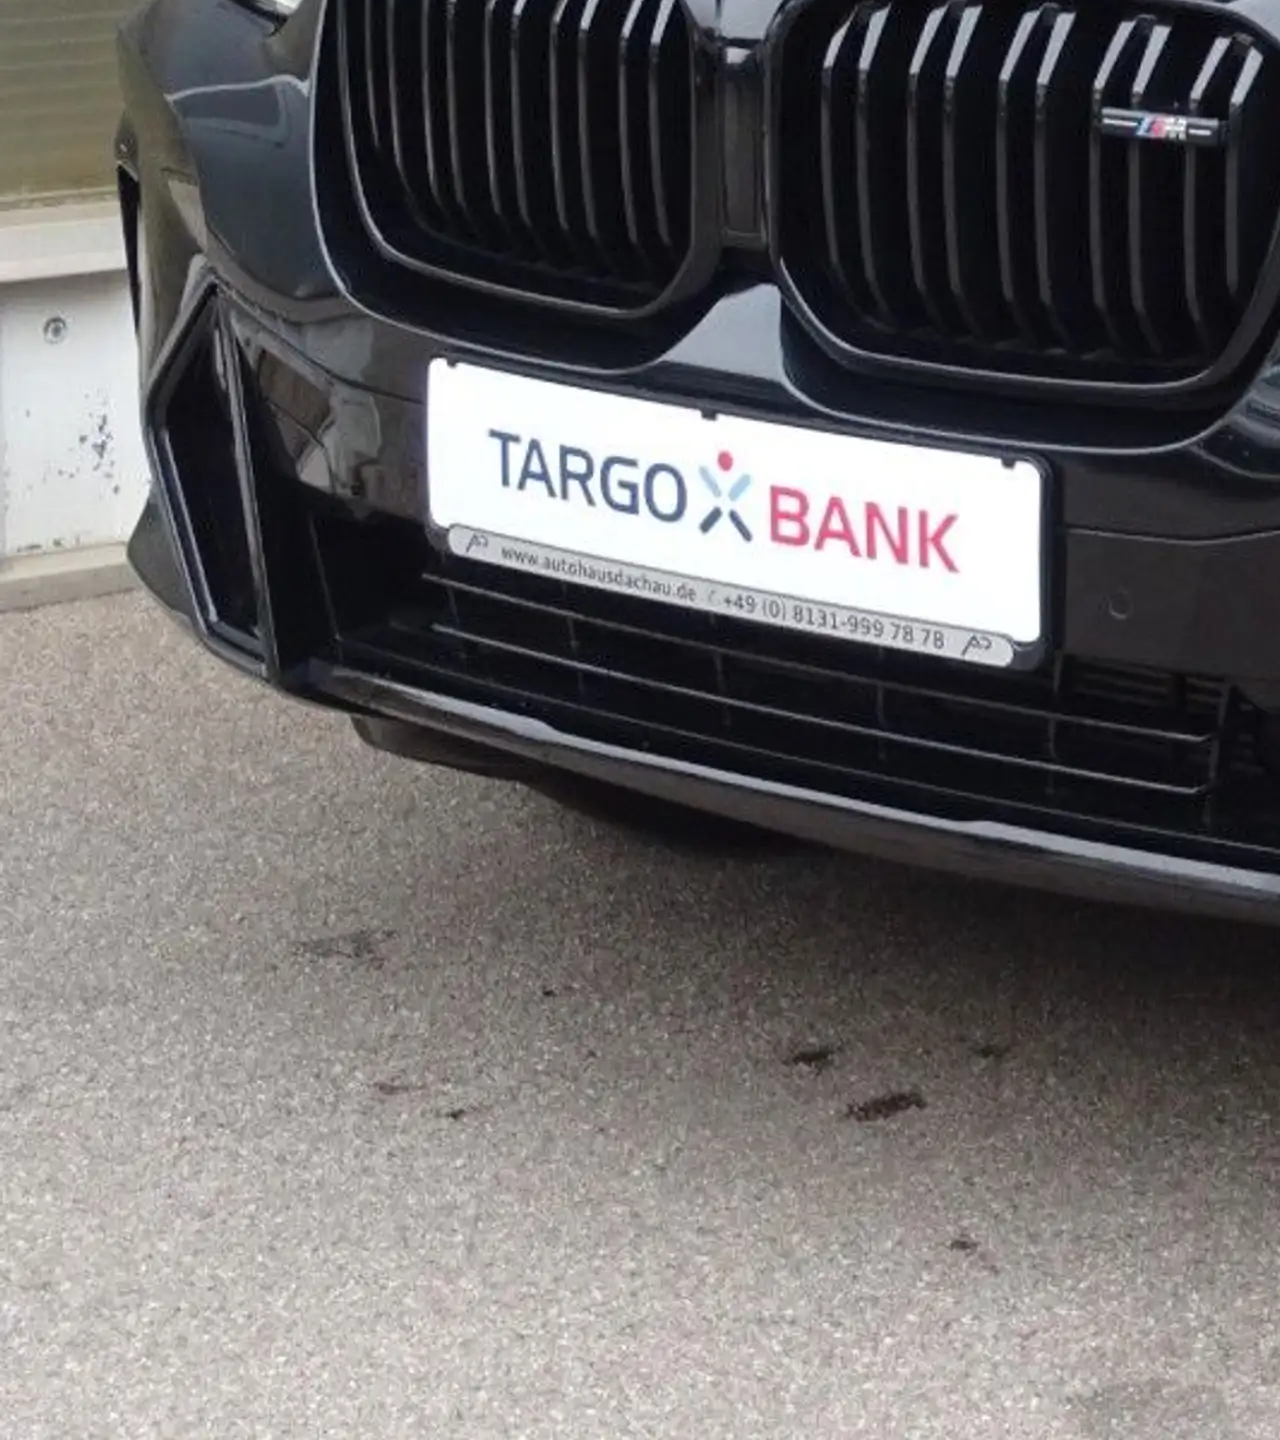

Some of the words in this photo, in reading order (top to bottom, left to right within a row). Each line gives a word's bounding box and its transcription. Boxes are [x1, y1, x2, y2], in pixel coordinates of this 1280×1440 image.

[488, 429, 688, 523] TARGO
[769, 485, 960, 574] BANK
[724, 596, 756, 614] +49
[762, 599, 787, 621] (0)
[793, 605, 884, 638] 8131-999
[890, 622, 914, 643] 78
[922, 628, 945, 650] 78
